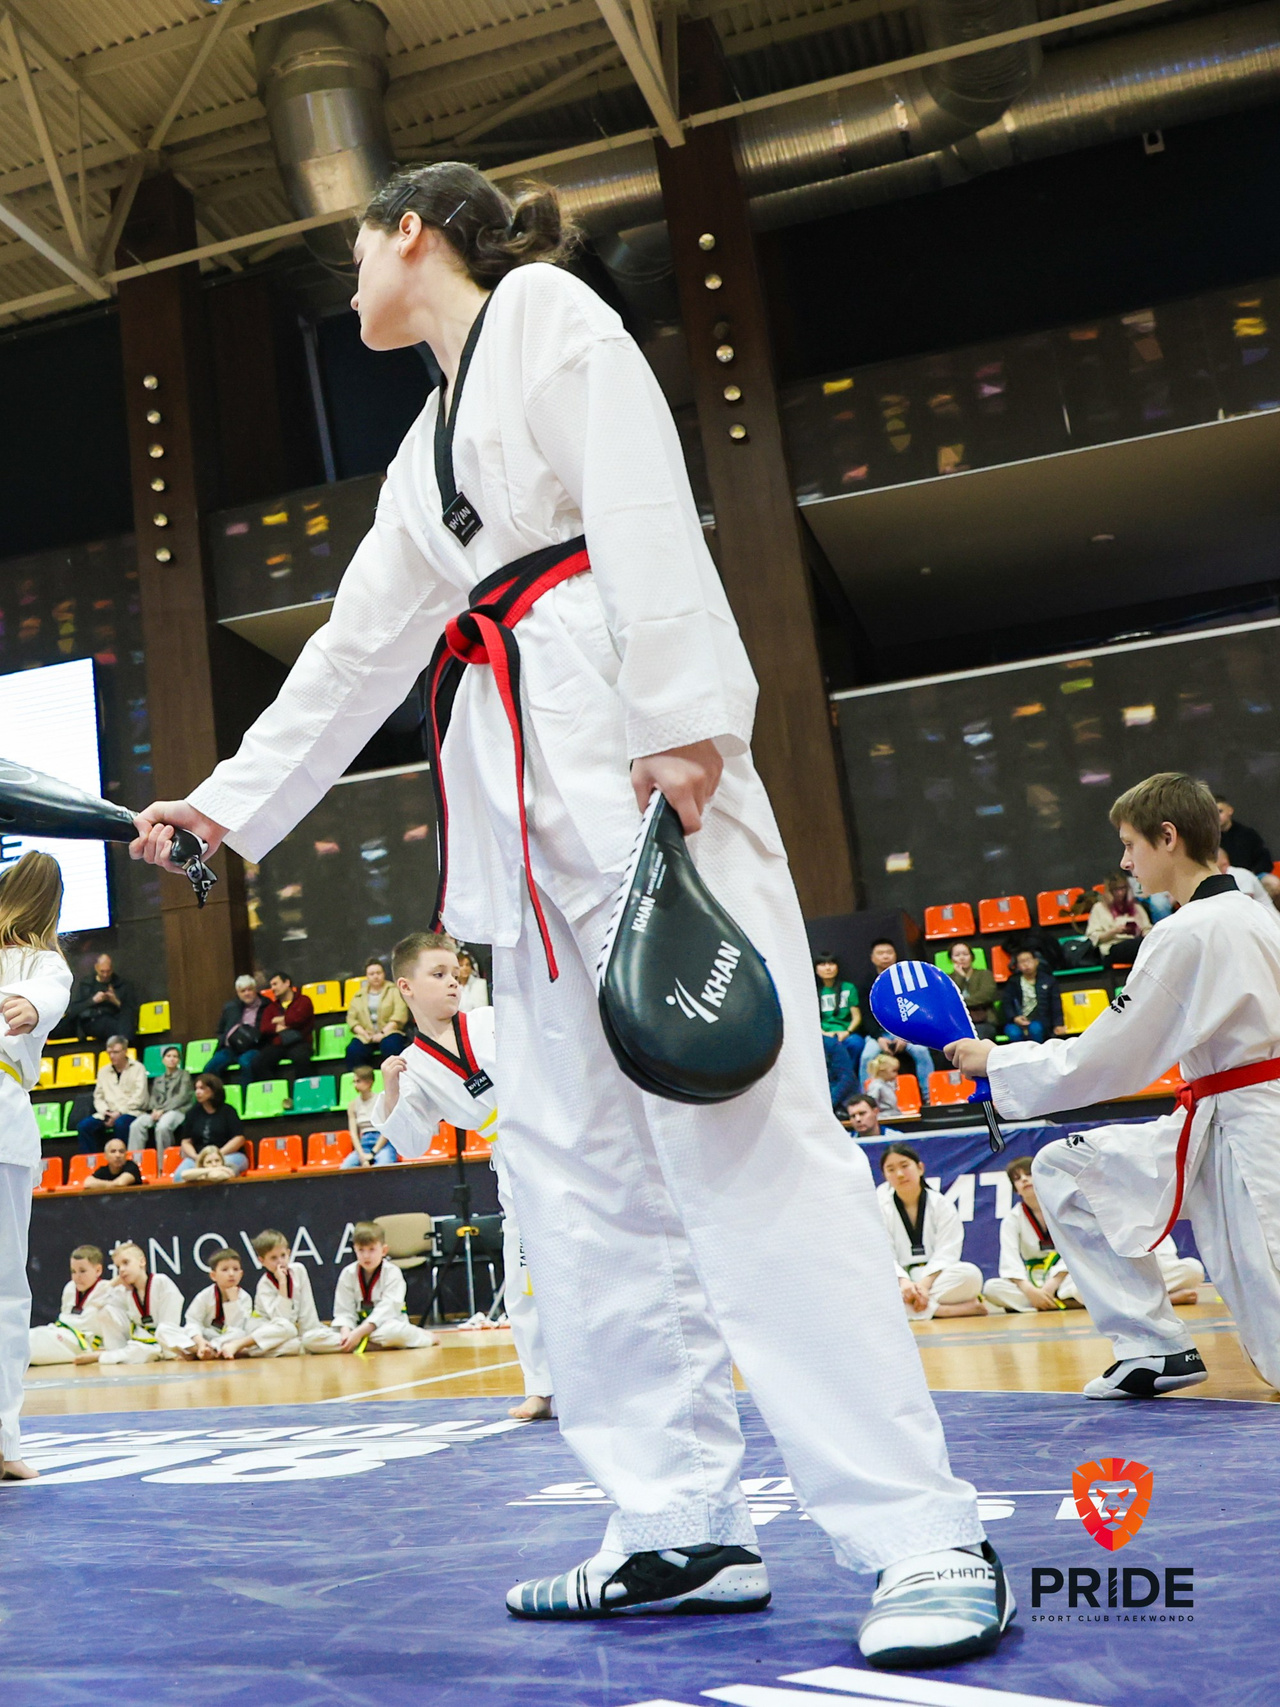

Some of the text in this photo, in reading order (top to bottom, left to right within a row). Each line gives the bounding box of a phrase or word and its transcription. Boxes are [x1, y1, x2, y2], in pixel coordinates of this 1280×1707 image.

[631, 895, 656, 933] KHAN
[691, 940, 741, 1008] KHAN
[936, 1567, 986, 1581] KHAN
